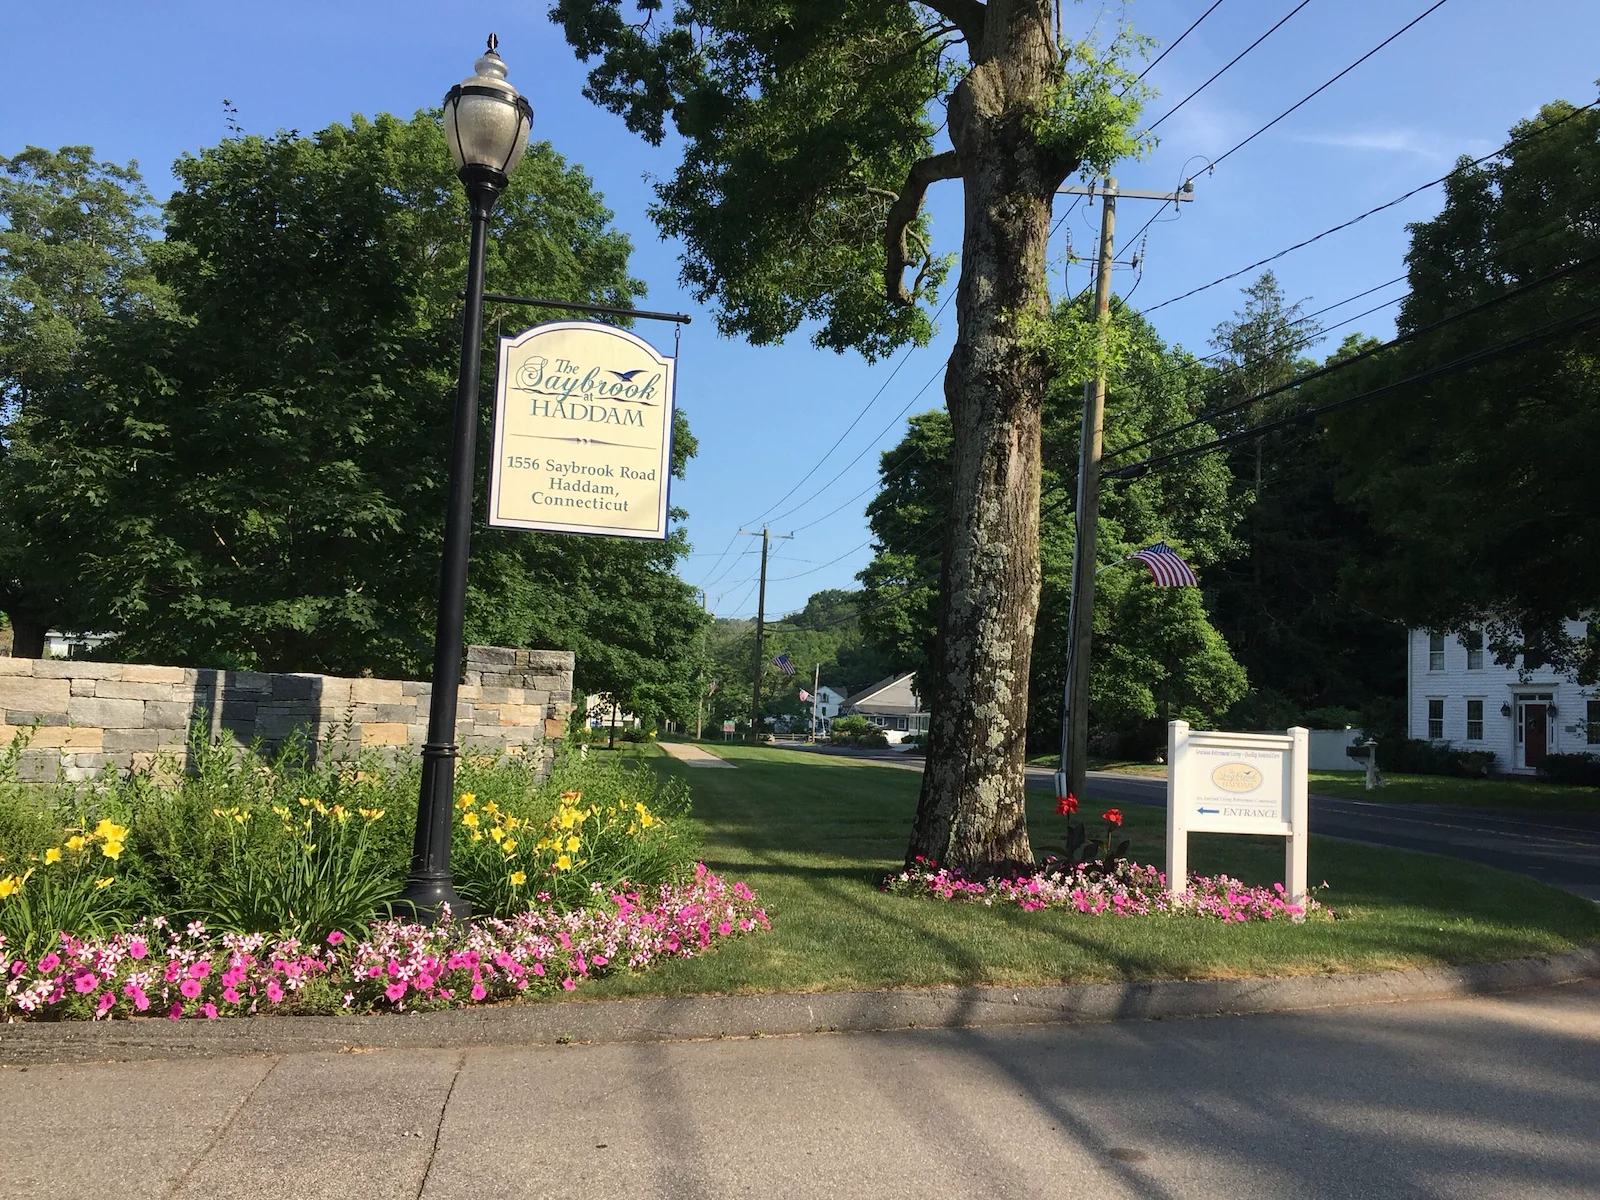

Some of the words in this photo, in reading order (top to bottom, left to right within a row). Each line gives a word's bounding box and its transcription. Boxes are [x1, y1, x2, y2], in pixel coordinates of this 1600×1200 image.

[555, 358, 579, 374] The
[516, 356, 662, 403] Saybrook
[583, 392, 594, 402] at
[530, 399, 645, 427] HADDAM
[507, 456, 540, 471] 1556
[546, 459, 614, 478] Saybrook
[619, 466, 656, 481] Road
[548, 477, 620, 498] Haddam,
[531, 491, 629, 512] Connecticut
[1223, 807, 1278, 818] ENTRANCE
